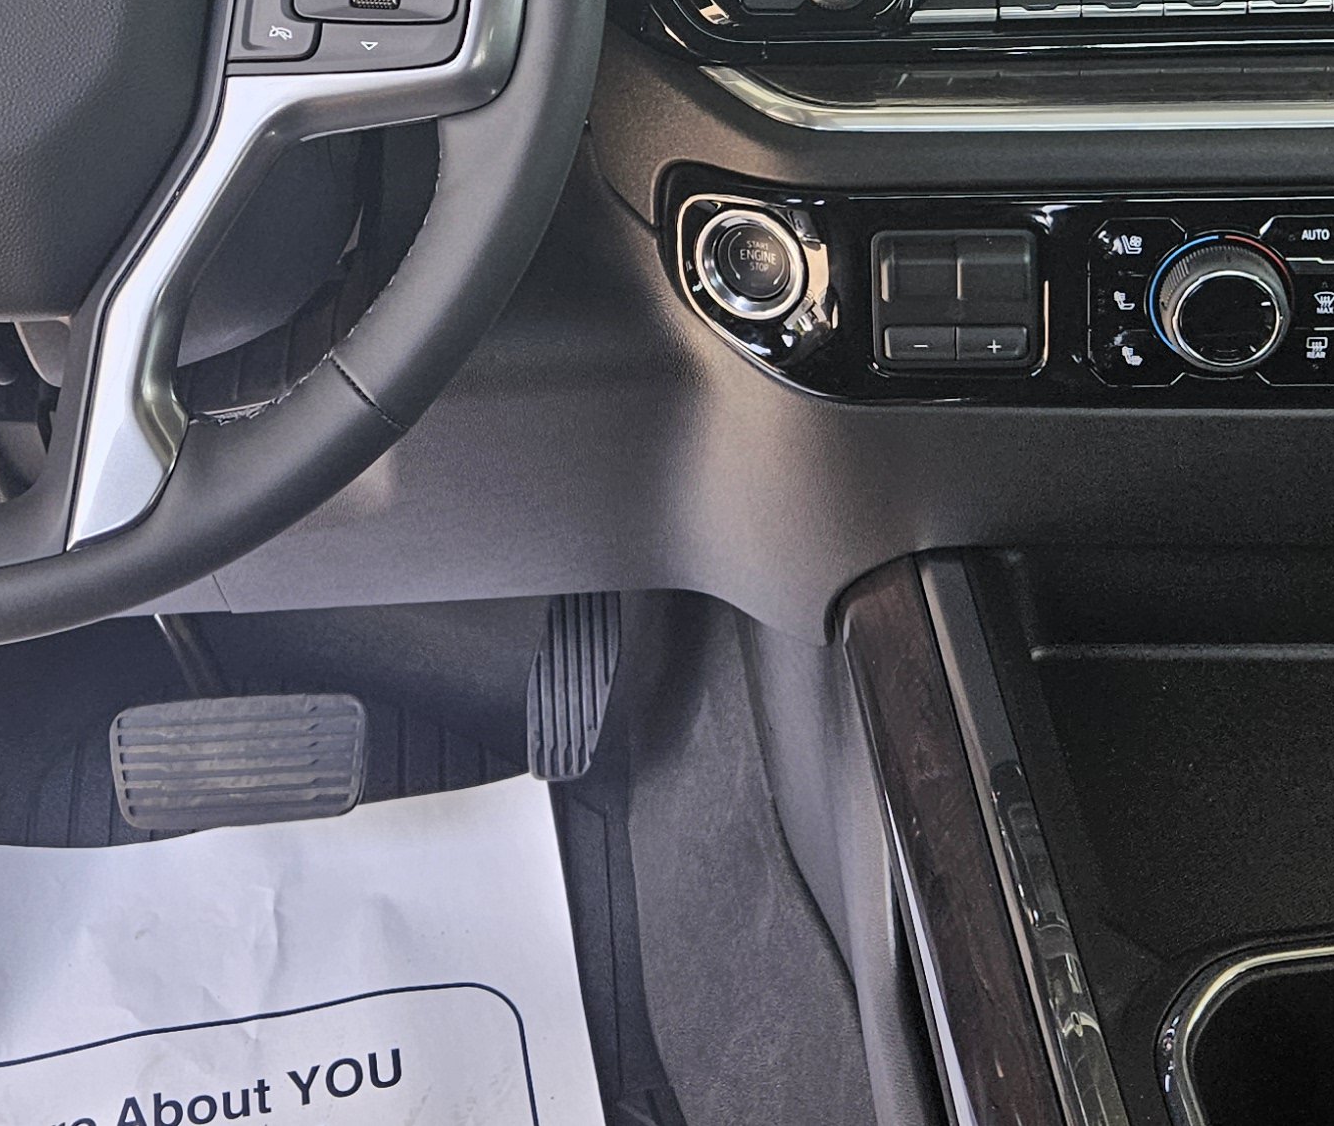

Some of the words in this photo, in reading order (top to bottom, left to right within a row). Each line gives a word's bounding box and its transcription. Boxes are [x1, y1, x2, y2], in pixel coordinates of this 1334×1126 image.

[1301, 228, 1330, 240] AUTO
[746, 240, 769, 251] START
[739, 248, 777, 265] ENGINE
[749, 261, 769, 272] STOP
[1316, 306, 1334, 314] MAX
[1306, 351, 1326, 359] REAR
[115, 1078, 271, 1126] About
[286, 1048, 403, 1106] YOU
